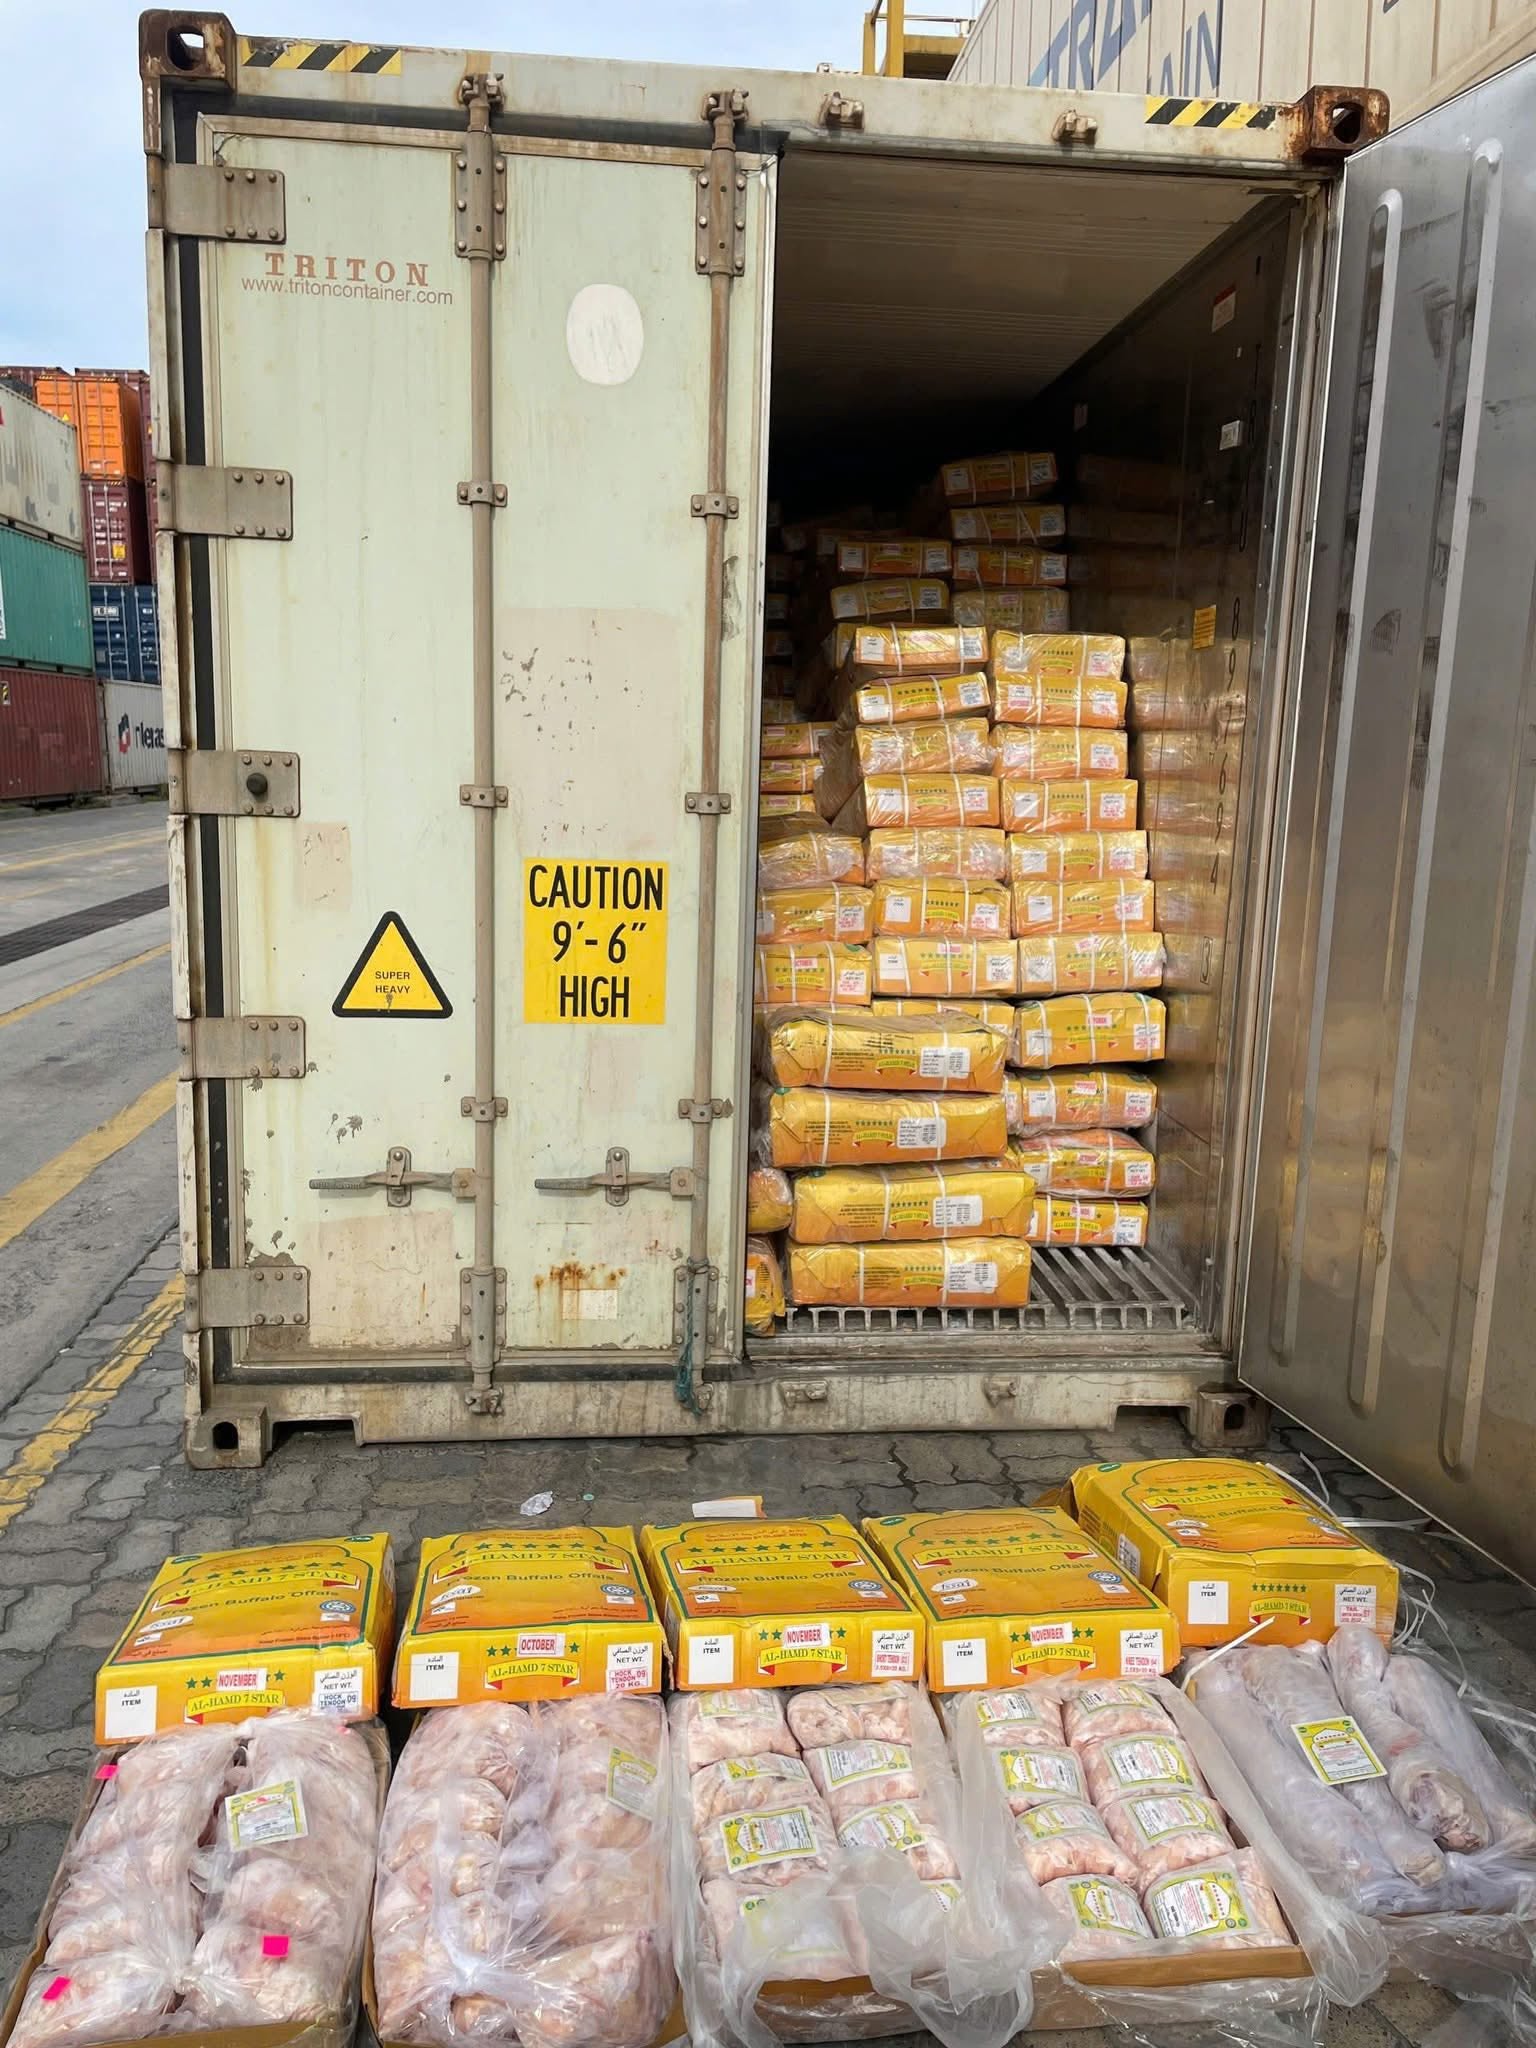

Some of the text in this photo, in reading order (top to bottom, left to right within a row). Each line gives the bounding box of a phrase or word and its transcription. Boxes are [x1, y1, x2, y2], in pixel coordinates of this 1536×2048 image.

[264, 252, 429, 287] TRITON
[241, 277, 453, 305] www.tritoncontainer.com
[528, 864, 664, 911] CAUTION
[374, 971, 411, 980] SUPER
[375, 985, 411, 994] HEAVY
[559, 975, 630, 1018] HIGH
[924, 1543, 1083, 1560] AL-HAMD 7 STAR
[562, 1552, 616, 1566] STAR
[690, 1555, 778, 1566] AL-HAMD
[796, 1552, 850, 1561] STAR
[506, 1572, 563, 1581] Buffalo
[568, 1572, 614, 1581] Offals
[698, 1571, 857, 1583] Frozen Buffalo Offals
[224, 1593, 285, 1607] Buffalo
[785, 1628, 822, 1643] NOVEMBER
[1030, 1627, 1065, 1641] NOVEMBER
[520, 1638, 556, 1652] OCTOBER
[764, 1648, 843, 1662] AL-HAMD 7 STAR
[956, 1649, 973, 1657] ITEM
[1015, 1647, 1091, 1664] AL-HAMD 7 STAR
[490, 1662, 574, 1679] AL-HAMD 7 STAR
[217, 1673, 258, 1688] NOVEMBER
[121, 1698, 141, 1706] ITEM
[190, 1692, 280, 1713] AL-HAMD 7 STAR
[324, 1693, 342, 1701] HOCK
